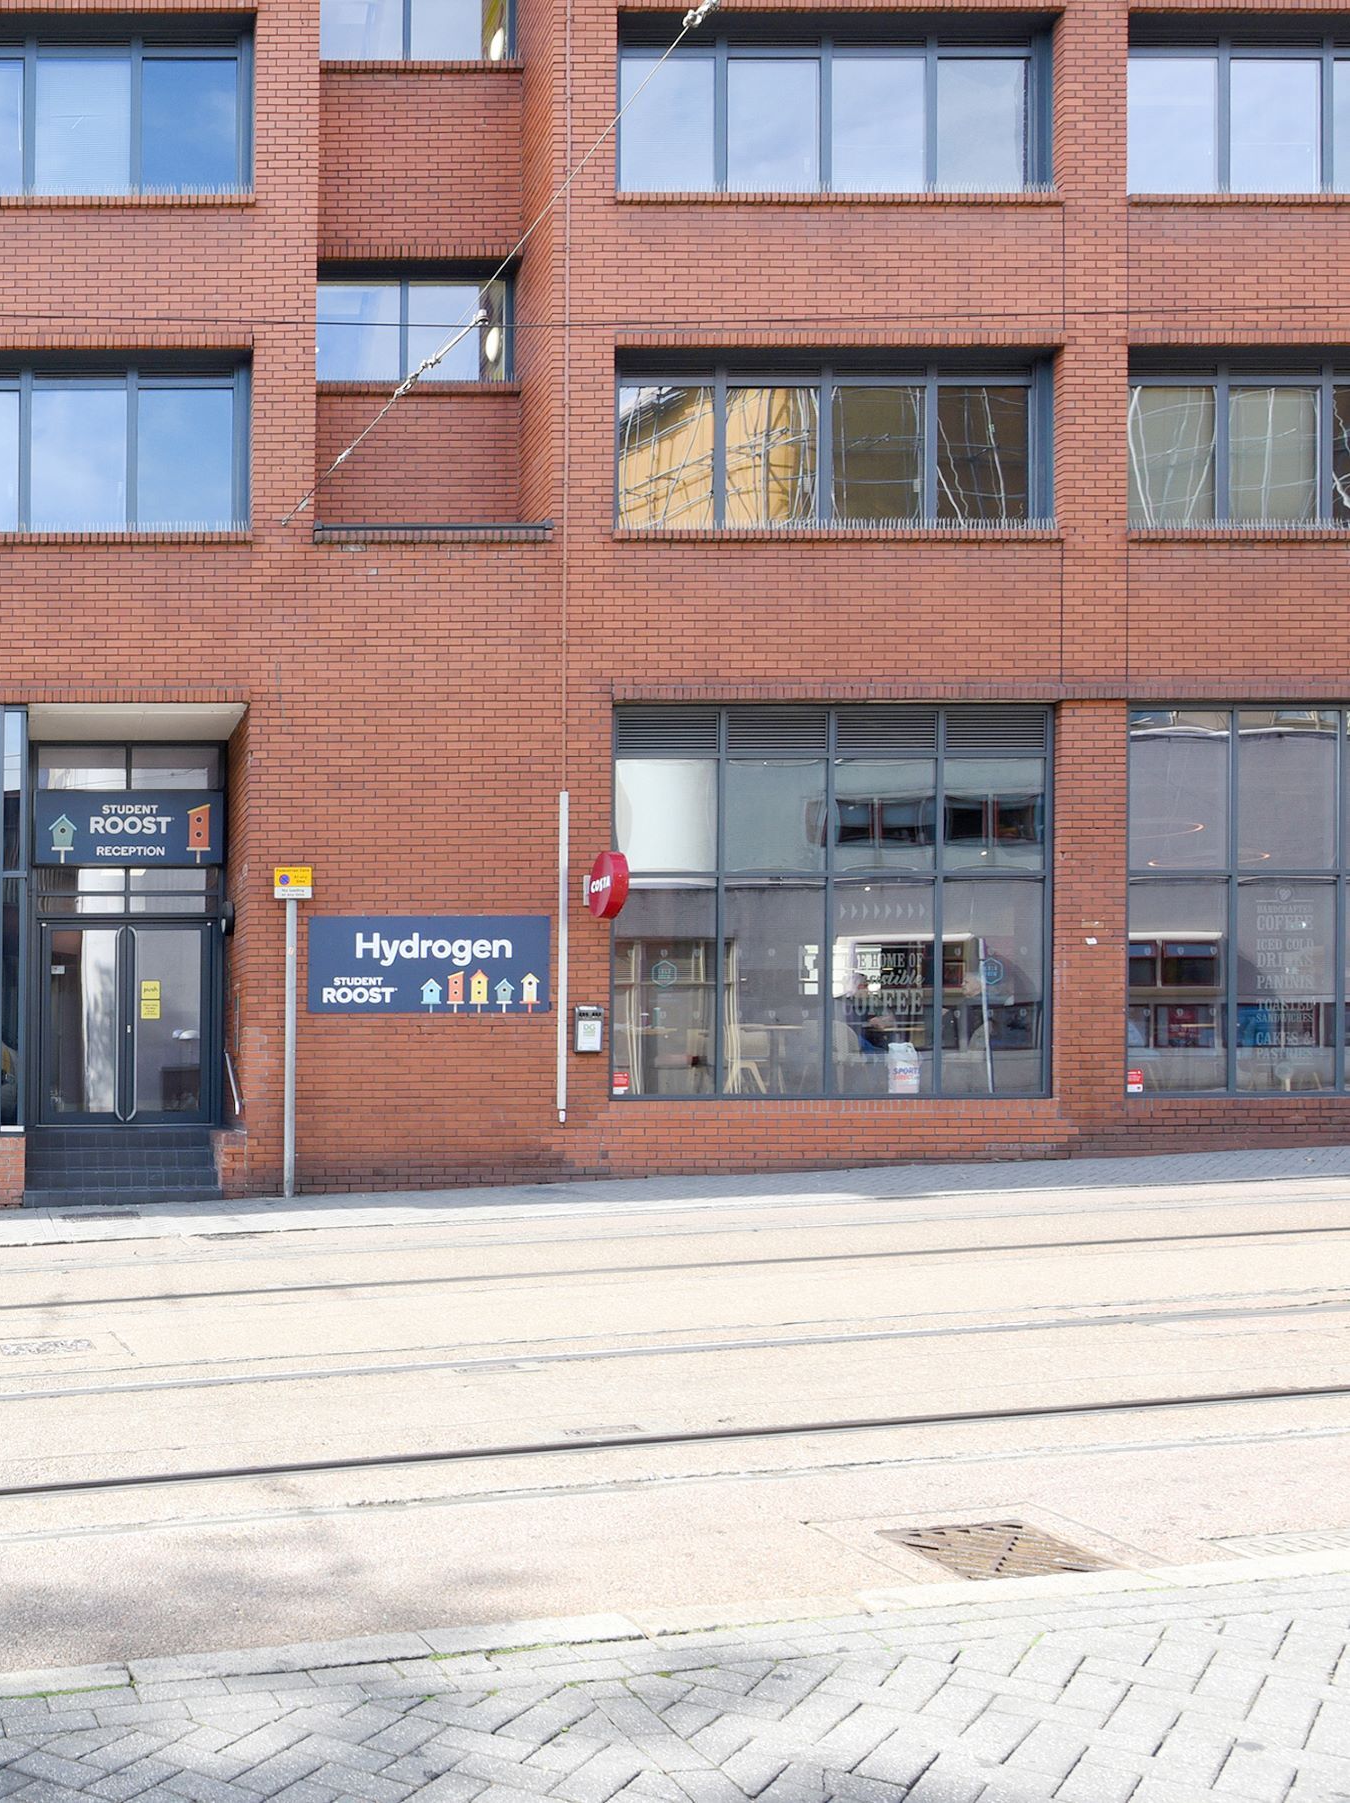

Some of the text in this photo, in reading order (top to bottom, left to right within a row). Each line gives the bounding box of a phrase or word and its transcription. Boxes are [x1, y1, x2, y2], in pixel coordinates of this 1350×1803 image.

[102, 804, 159, 815] STUDENT
[90, 816, 172, 835] ROOST
[96, 846, 166, 857] RECEPTION
[591, 875, 611, 894] COSTA
[1257, 914, 1314, 931] COFFEE
[355, 932, 513, 966] Hydrogen
[1257, 938, 1282, 951] ICED
[872, 953, 905, 968] HOME
[909, 953, 924, 968] OF
[333, 977, 383, 986] STUDENT
[1256, 975, 1315, 989] PANINIS
[322, 987, 395, 1004] ROOST
